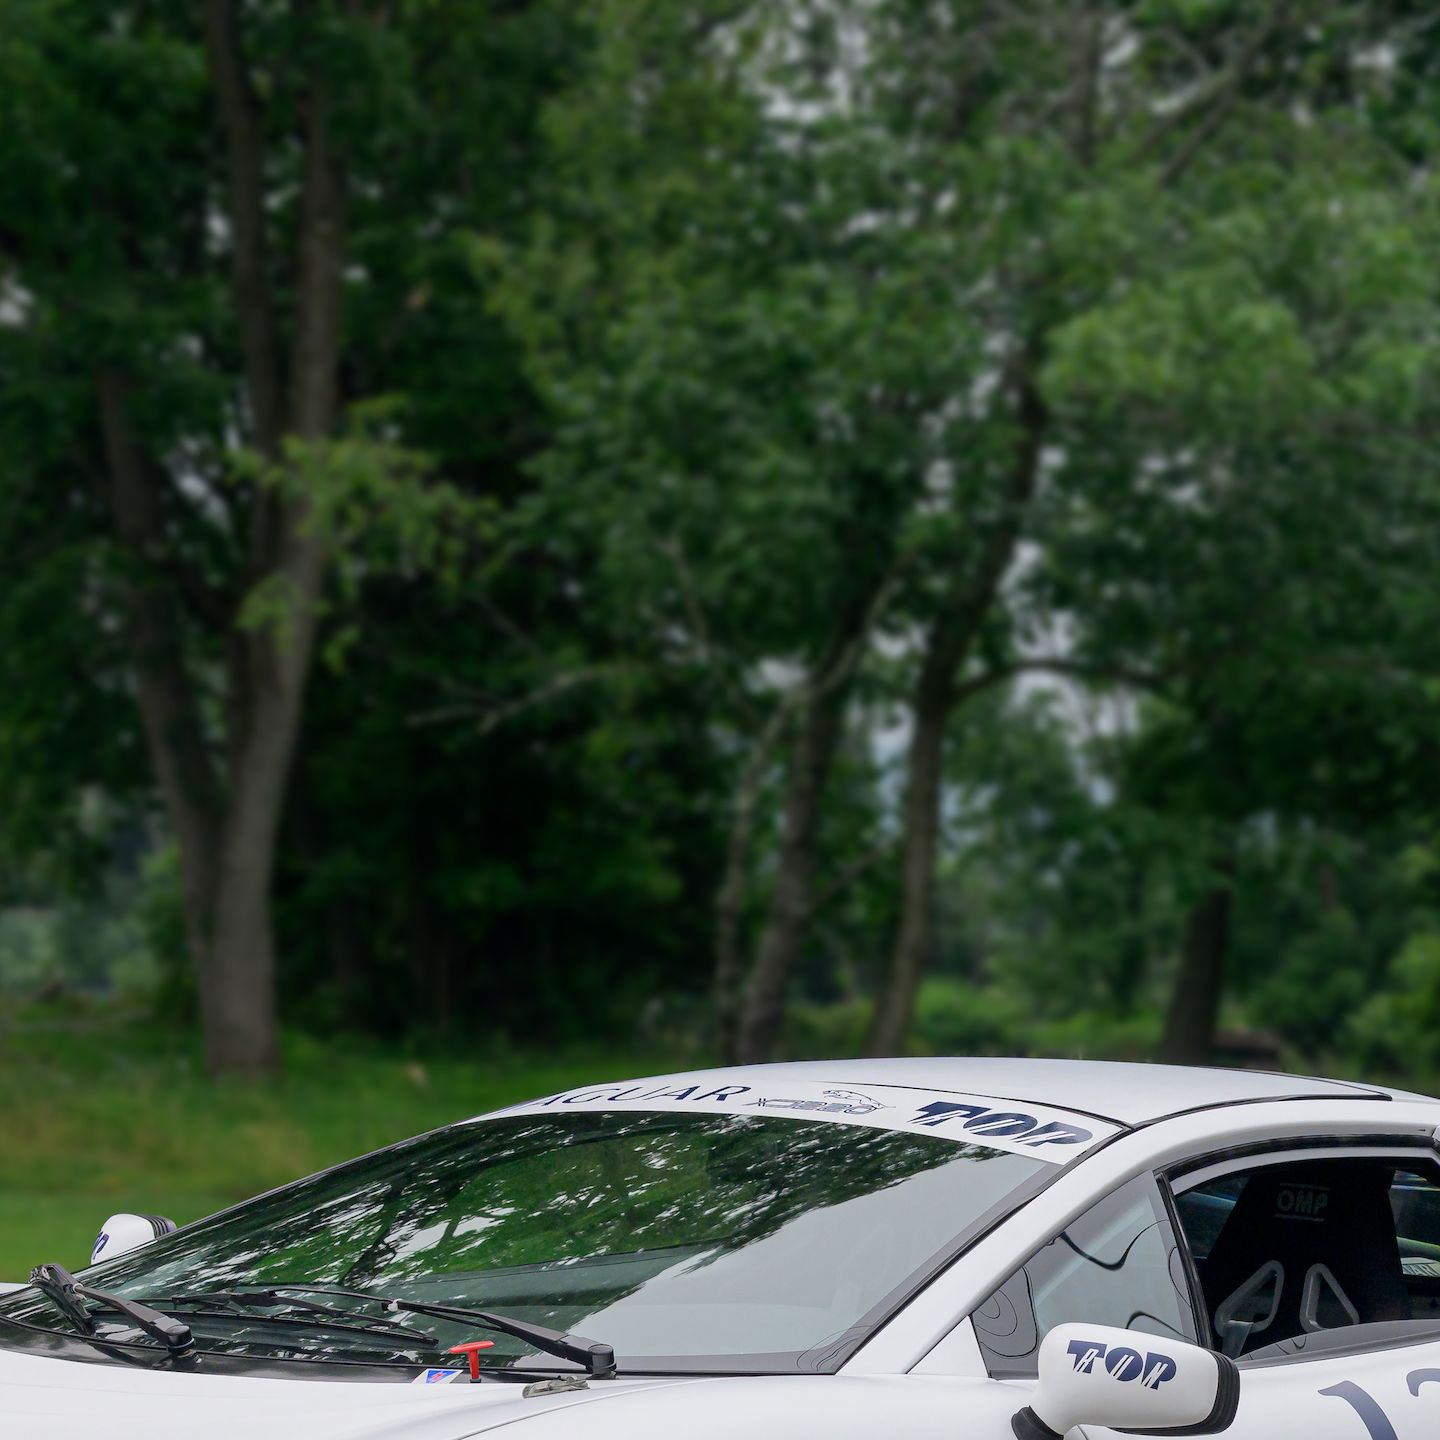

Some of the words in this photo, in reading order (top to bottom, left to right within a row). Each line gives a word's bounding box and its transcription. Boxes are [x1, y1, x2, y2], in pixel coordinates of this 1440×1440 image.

[505, 1085, 752, 1107] AGUAR
[907, 1101, 1093, 1147] TOP
[1067, 1340, 1177, 1390] TOP
